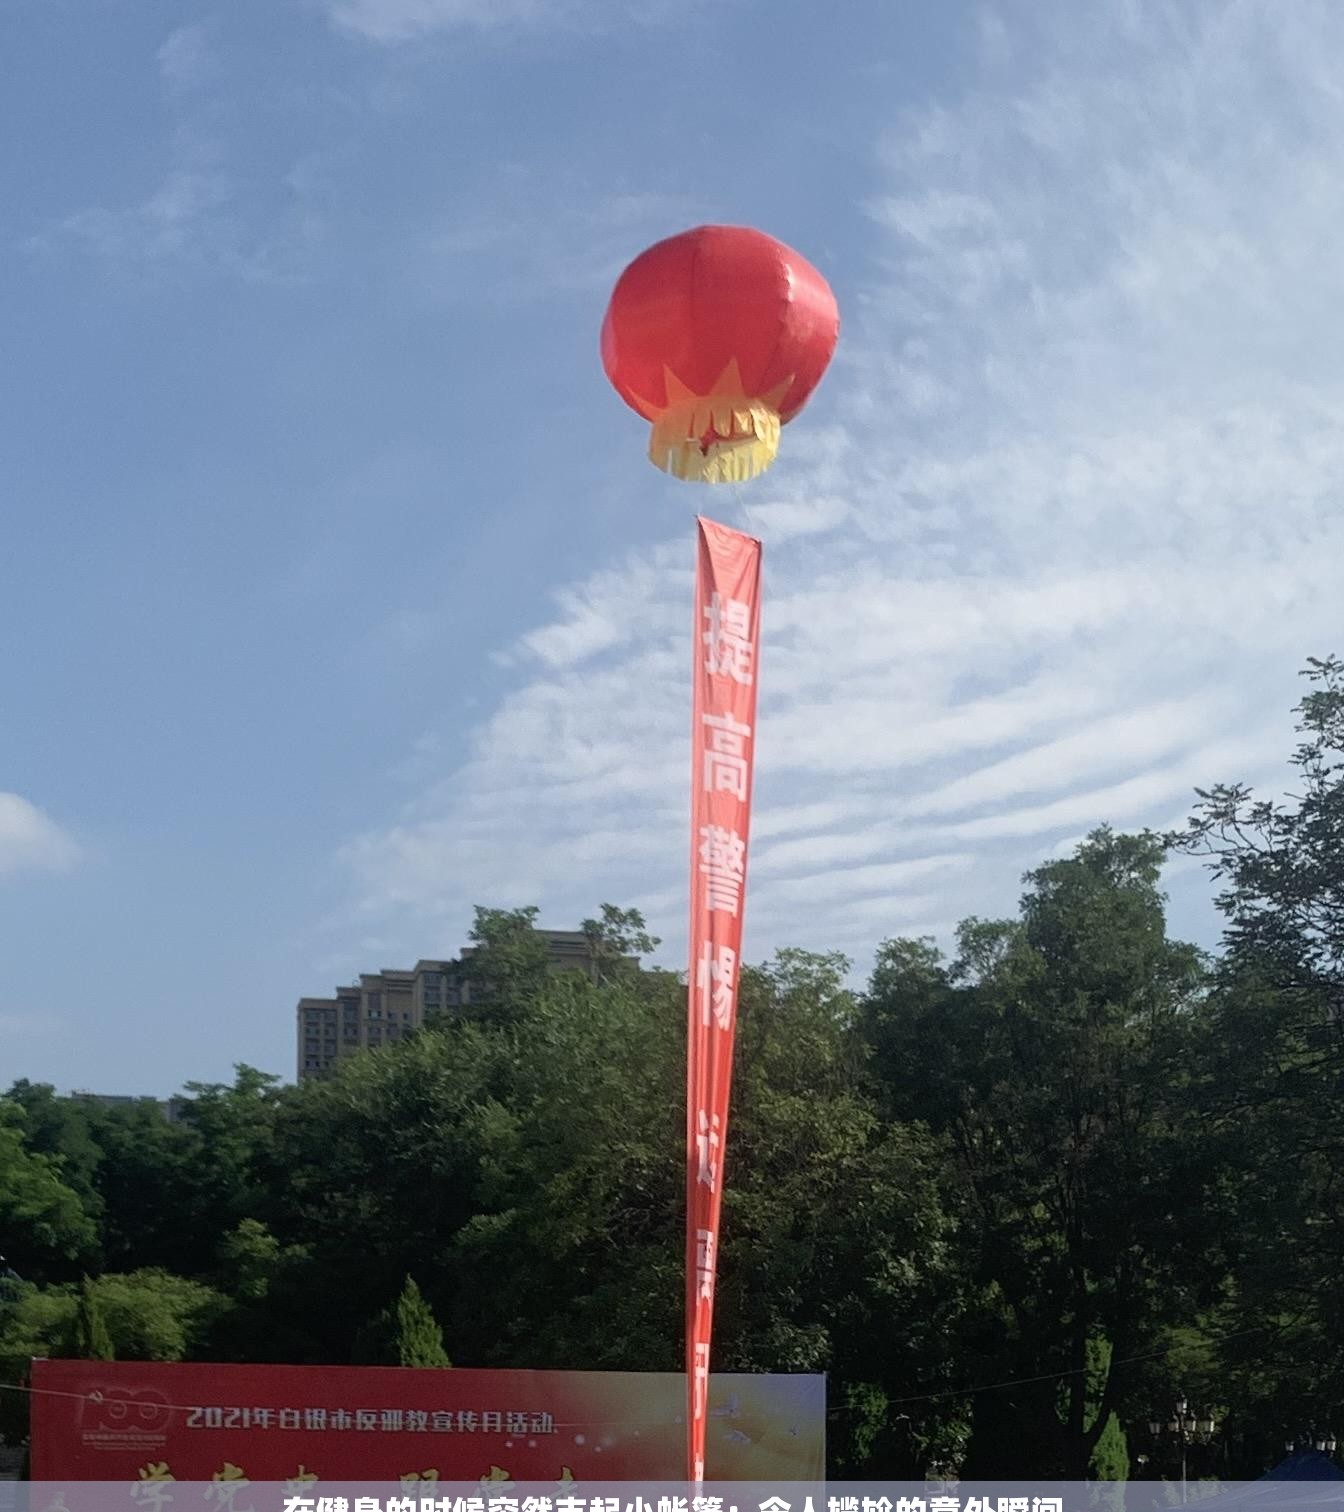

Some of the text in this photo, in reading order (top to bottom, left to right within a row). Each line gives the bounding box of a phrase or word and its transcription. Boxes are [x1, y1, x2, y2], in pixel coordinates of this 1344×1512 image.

[697, 591, 753, 1031] 提高警惕
[185, 1407, 555, 1434] 2021年白银市反邪教宣传月活动
